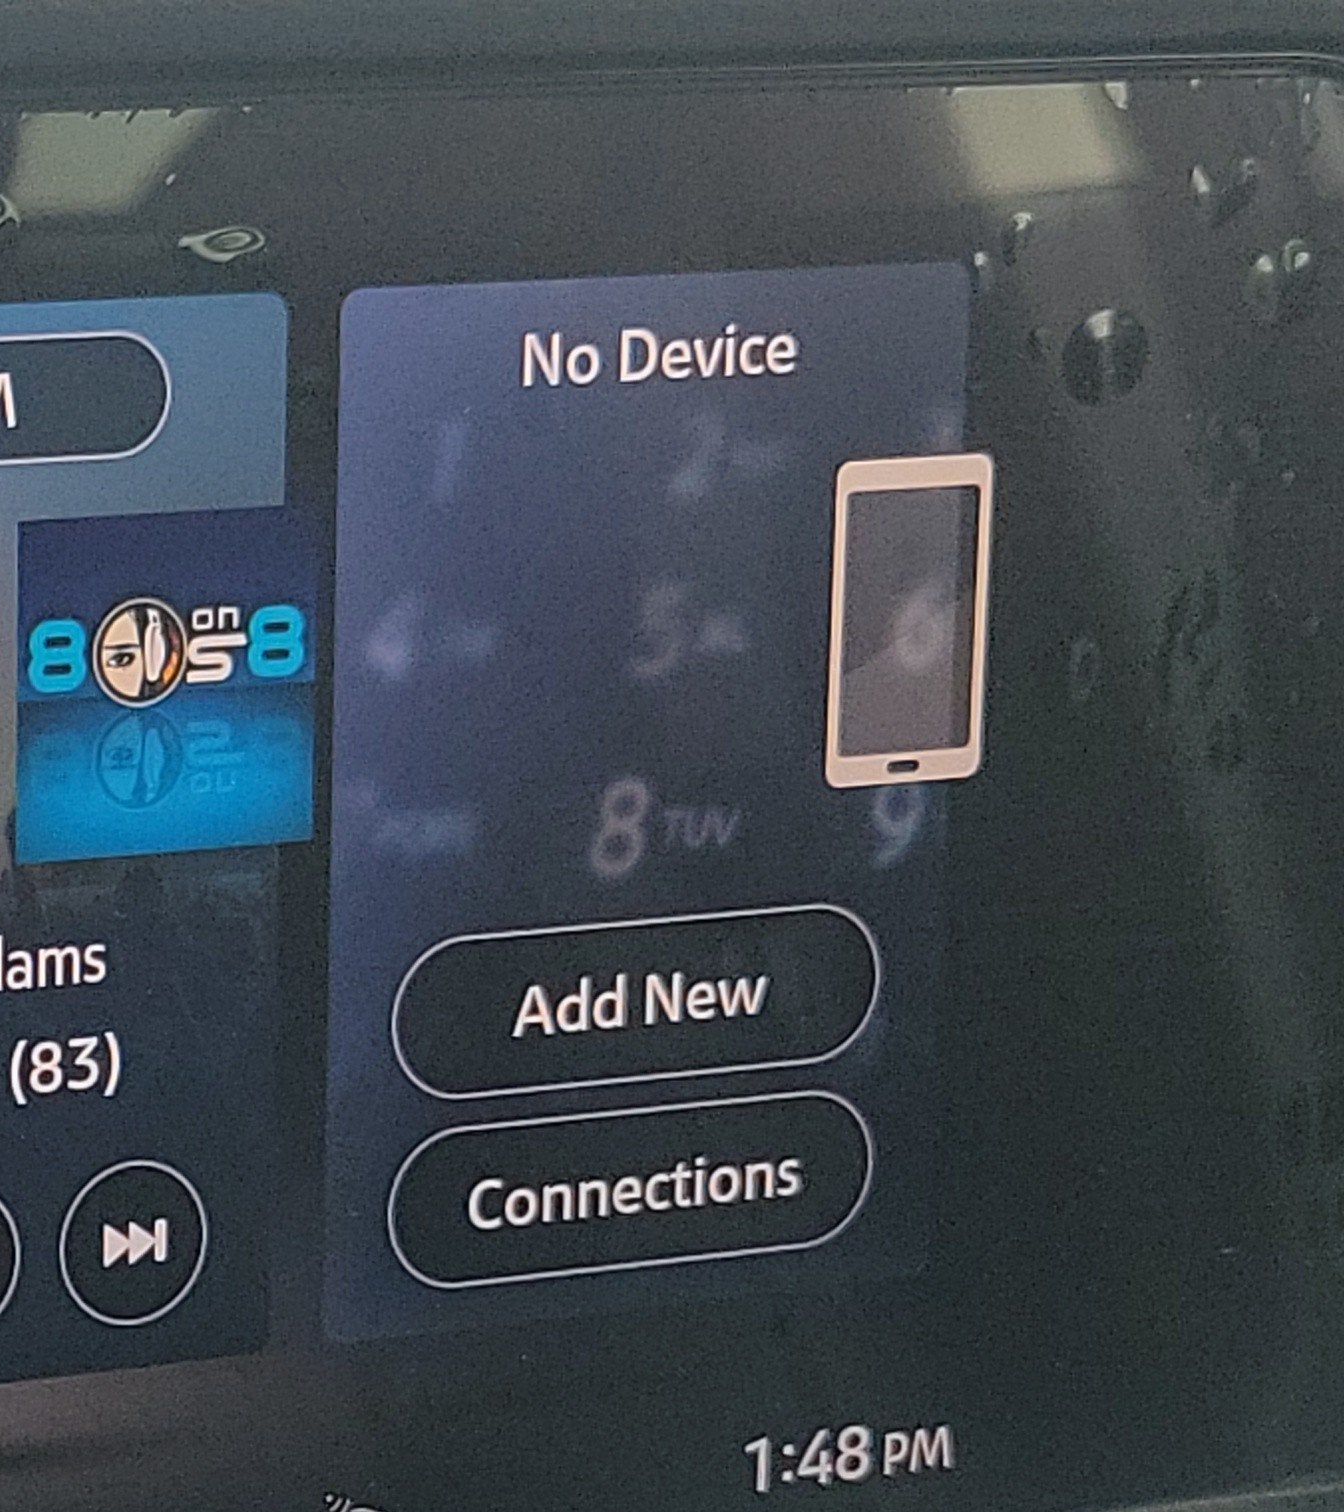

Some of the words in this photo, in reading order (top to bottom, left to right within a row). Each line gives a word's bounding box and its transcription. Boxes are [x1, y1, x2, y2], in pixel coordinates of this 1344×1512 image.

[521, 331, 598, 387] No
[618, 324, 798, 385] Device
[247, 604, 305, 677] 8
[512, 973, 626, 1038] Add
[644, 971, 769, 1026] New
[11, 1032, 122, 1104] (83)
[467, 1156, 803, 1231] Connections
[743, 1425, 871, 1494] 1:48
[883, 1424, 956, 1477] PM
